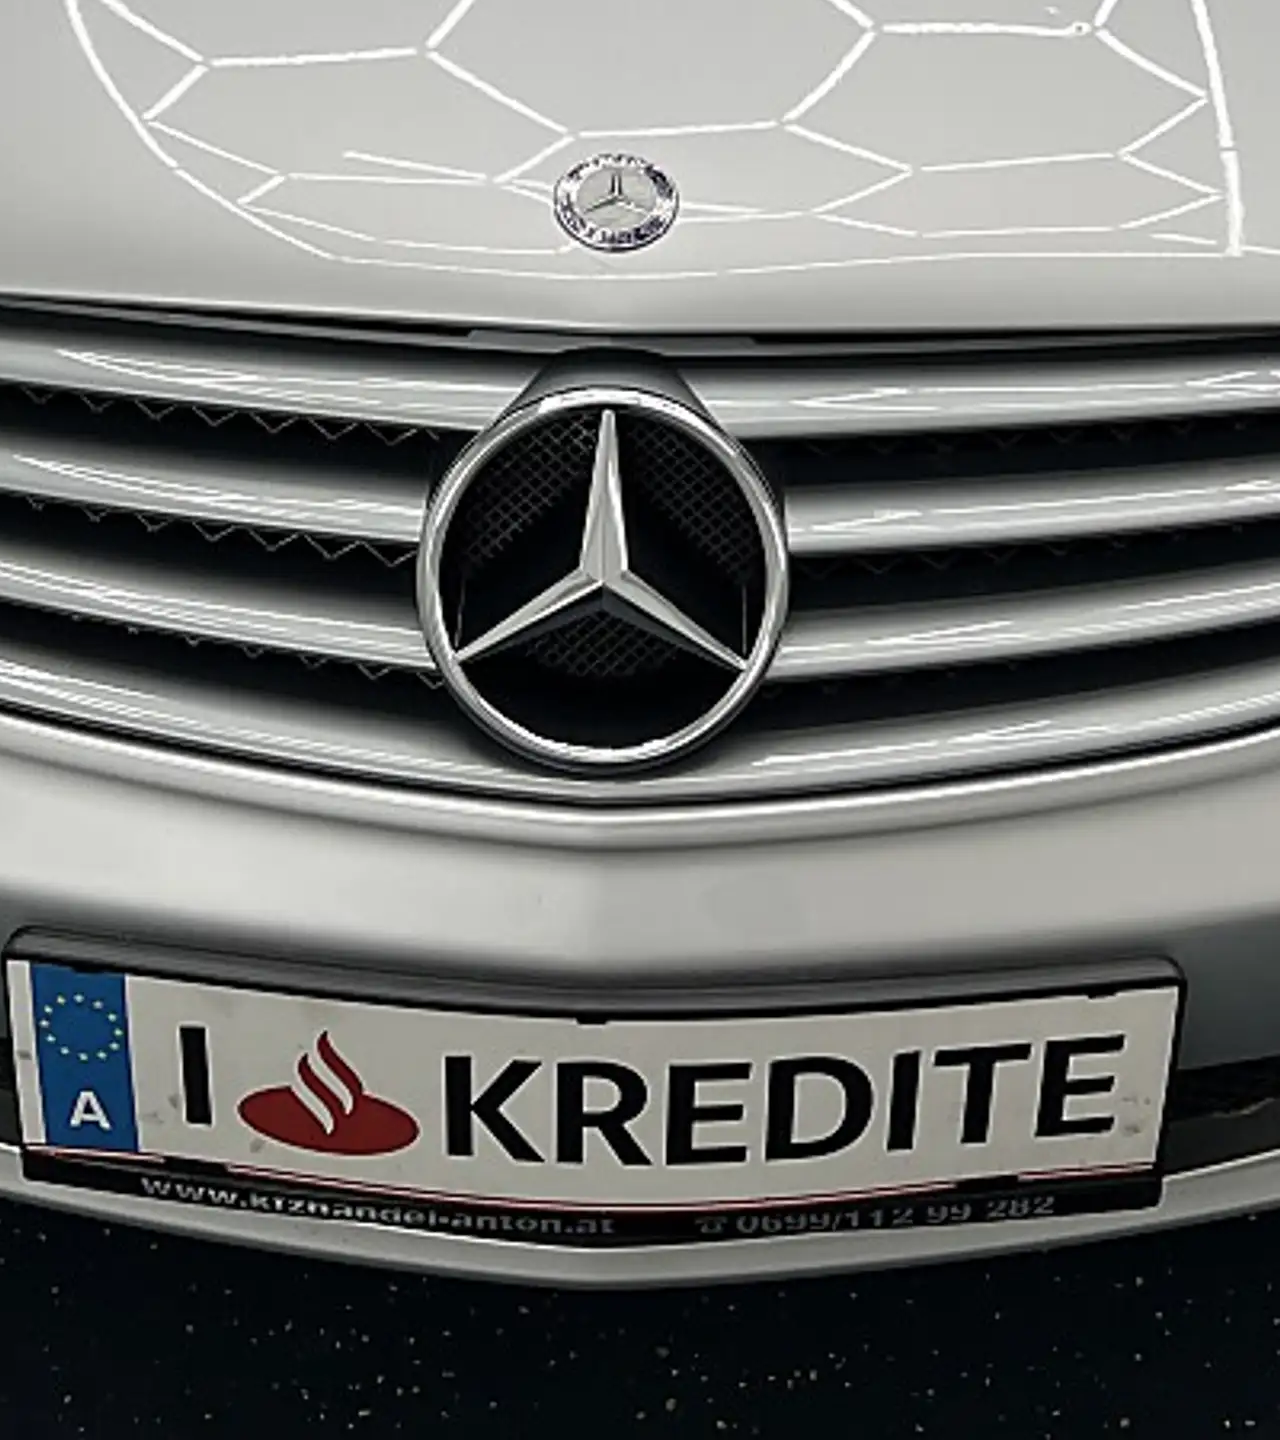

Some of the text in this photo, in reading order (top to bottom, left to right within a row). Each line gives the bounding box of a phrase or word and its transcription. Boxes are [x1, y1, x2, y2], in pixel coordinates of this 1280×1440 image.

[69, 1090, 113, 1131] A
[179, 1025, 1126, 1167] I KREDITE
